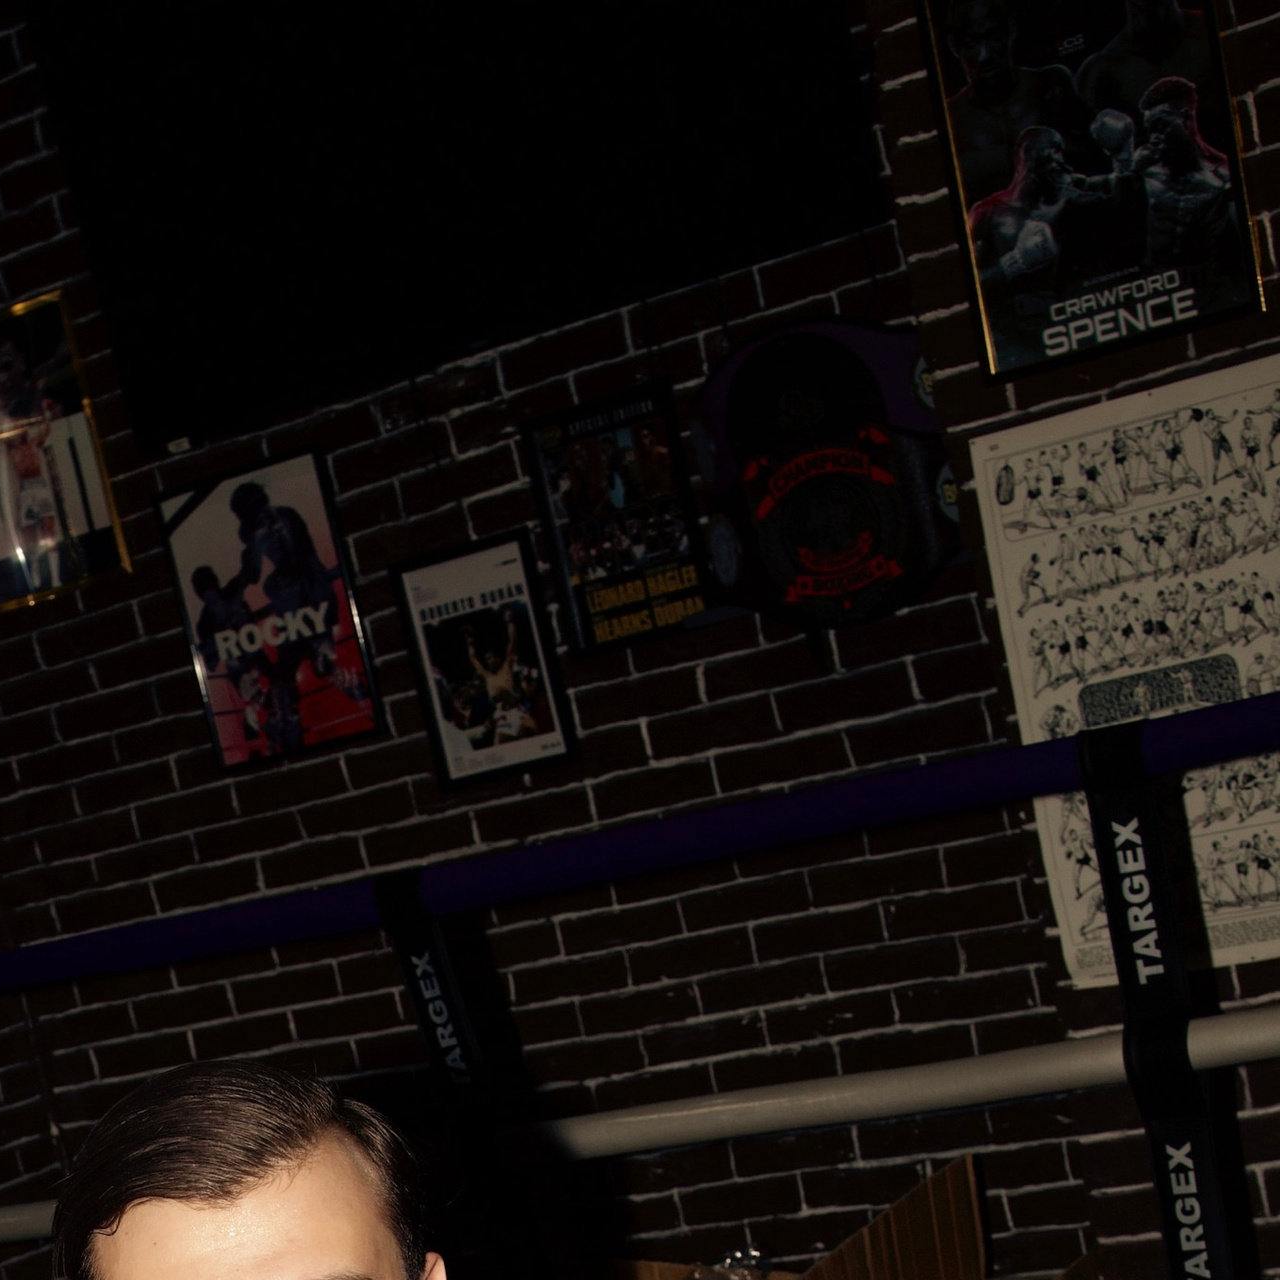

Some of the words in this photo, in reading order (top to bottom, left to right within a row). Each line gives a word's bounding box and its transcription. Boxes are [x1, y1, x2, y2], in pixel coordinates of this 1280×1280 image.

[1042, 288, 1200, 356] SPENCE
[1049, 269, 1181, 322] CRAWFORD
[214, 601, 329, 661] ROCKY
[1111, 816, 1165, 986] TARGEX
